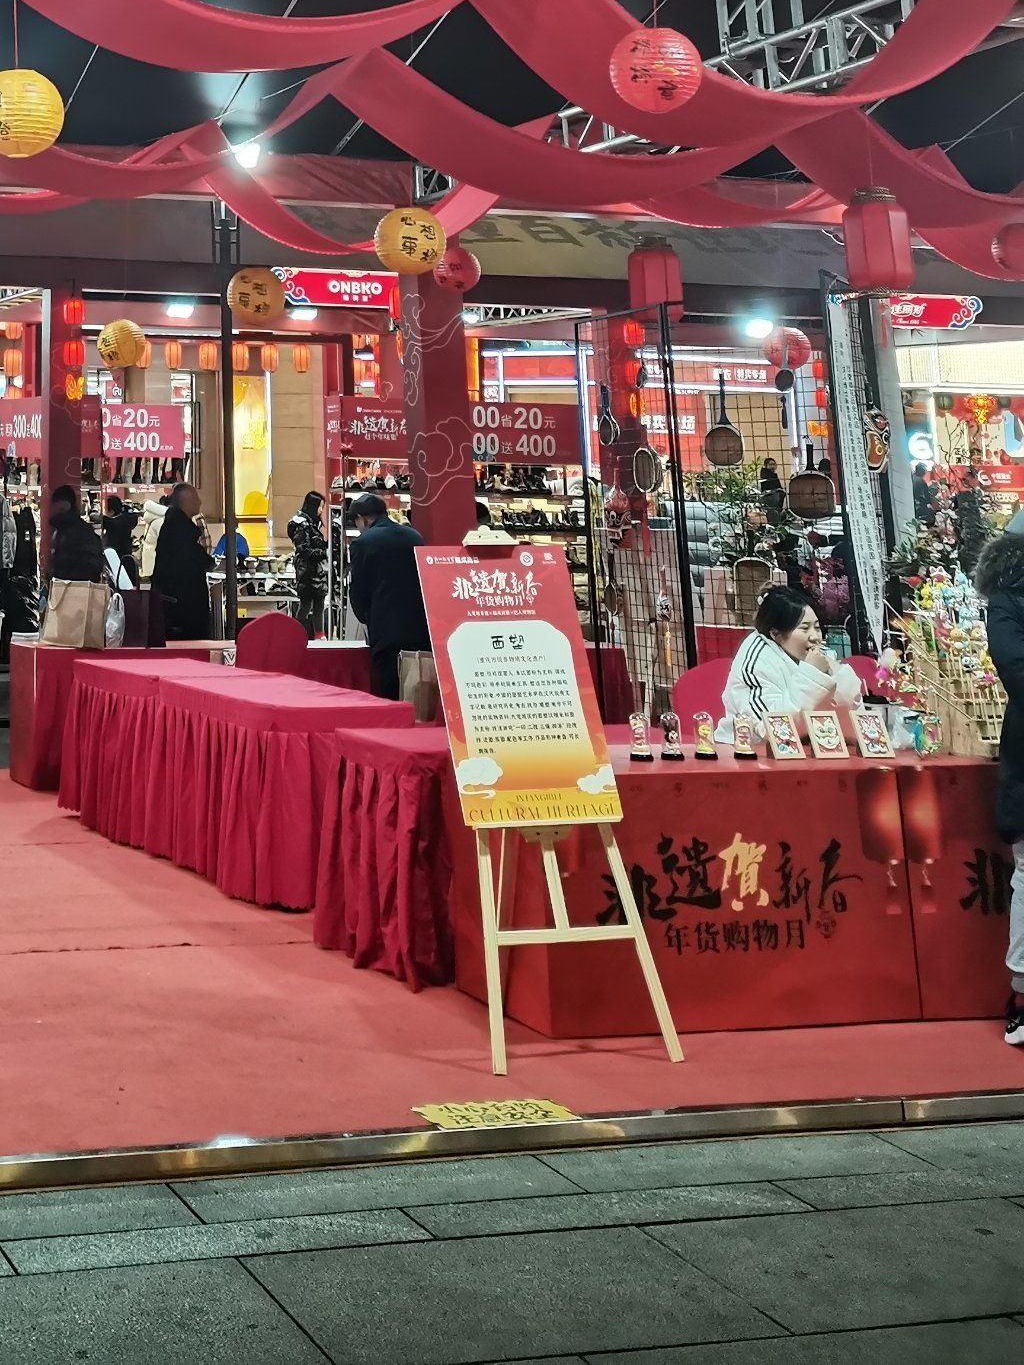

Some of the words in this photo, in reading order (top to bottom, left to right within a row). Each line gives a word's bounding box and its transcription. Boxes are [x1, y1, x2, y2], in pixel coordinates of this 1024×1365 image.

[328, 279, 383, 295] ONBKO
[473, 405, 556, 430] 00省20元
[473, 432, 557, 457] 00送400
[452, 569, 543, 600] 非遗贺新春
[491, 634, 525, 650] 面塑
[664, 919, 806, 955] 年货购物月
